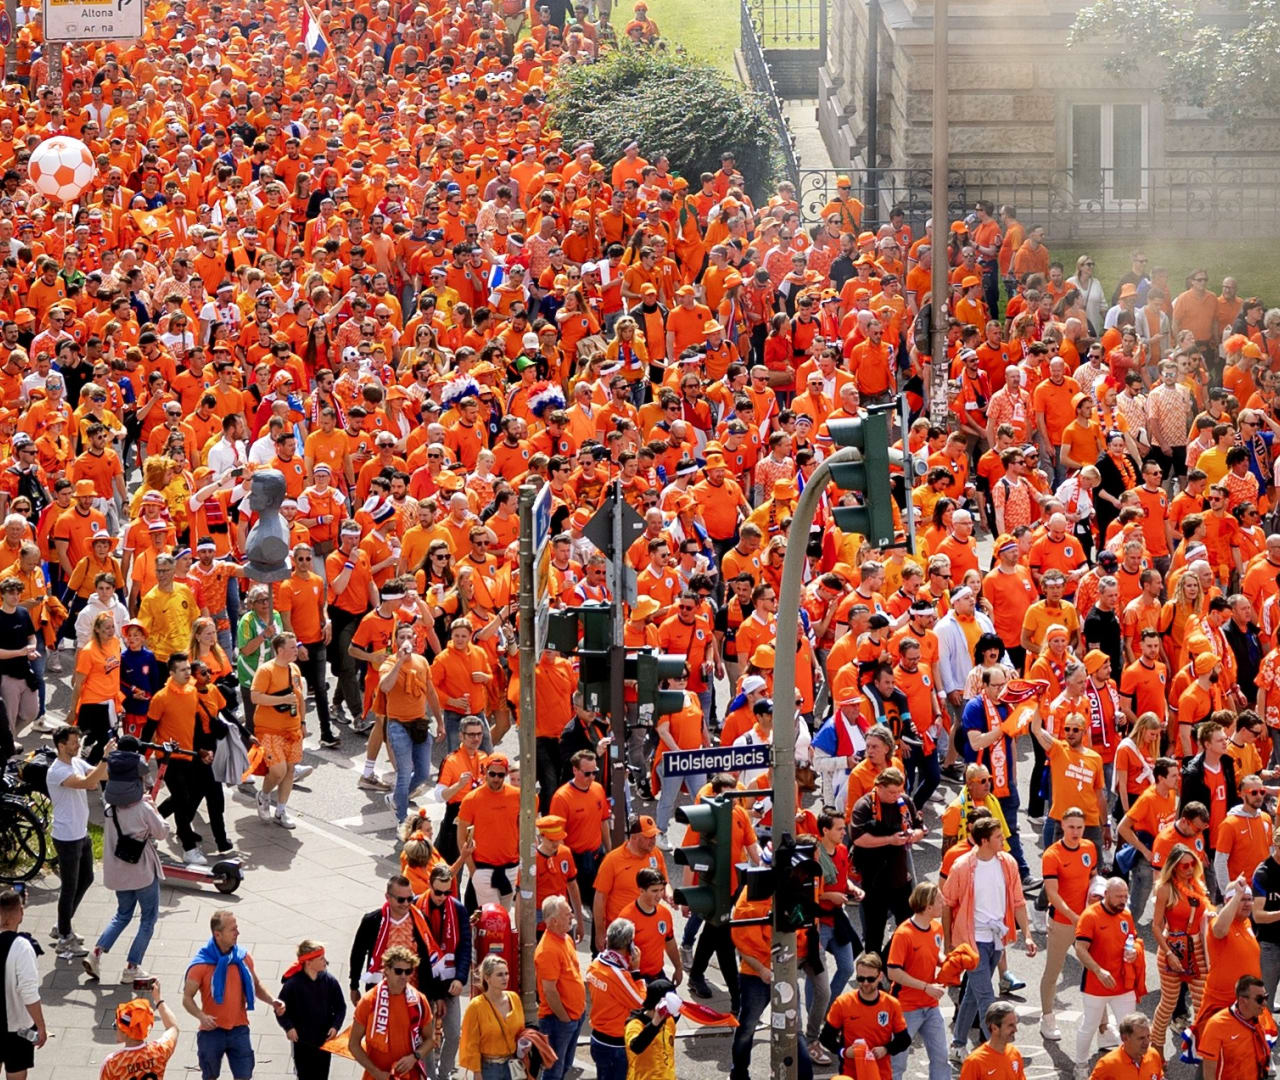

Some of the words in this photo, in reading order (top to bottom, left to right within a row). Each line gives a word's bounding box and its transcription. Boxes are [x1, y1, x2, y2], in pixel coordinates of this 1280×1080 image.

[81, 8, 113, 18] Altona
[1087, 692, 1101, 728] POLEN
[668, 748, 765, 772] Holstenglacis
